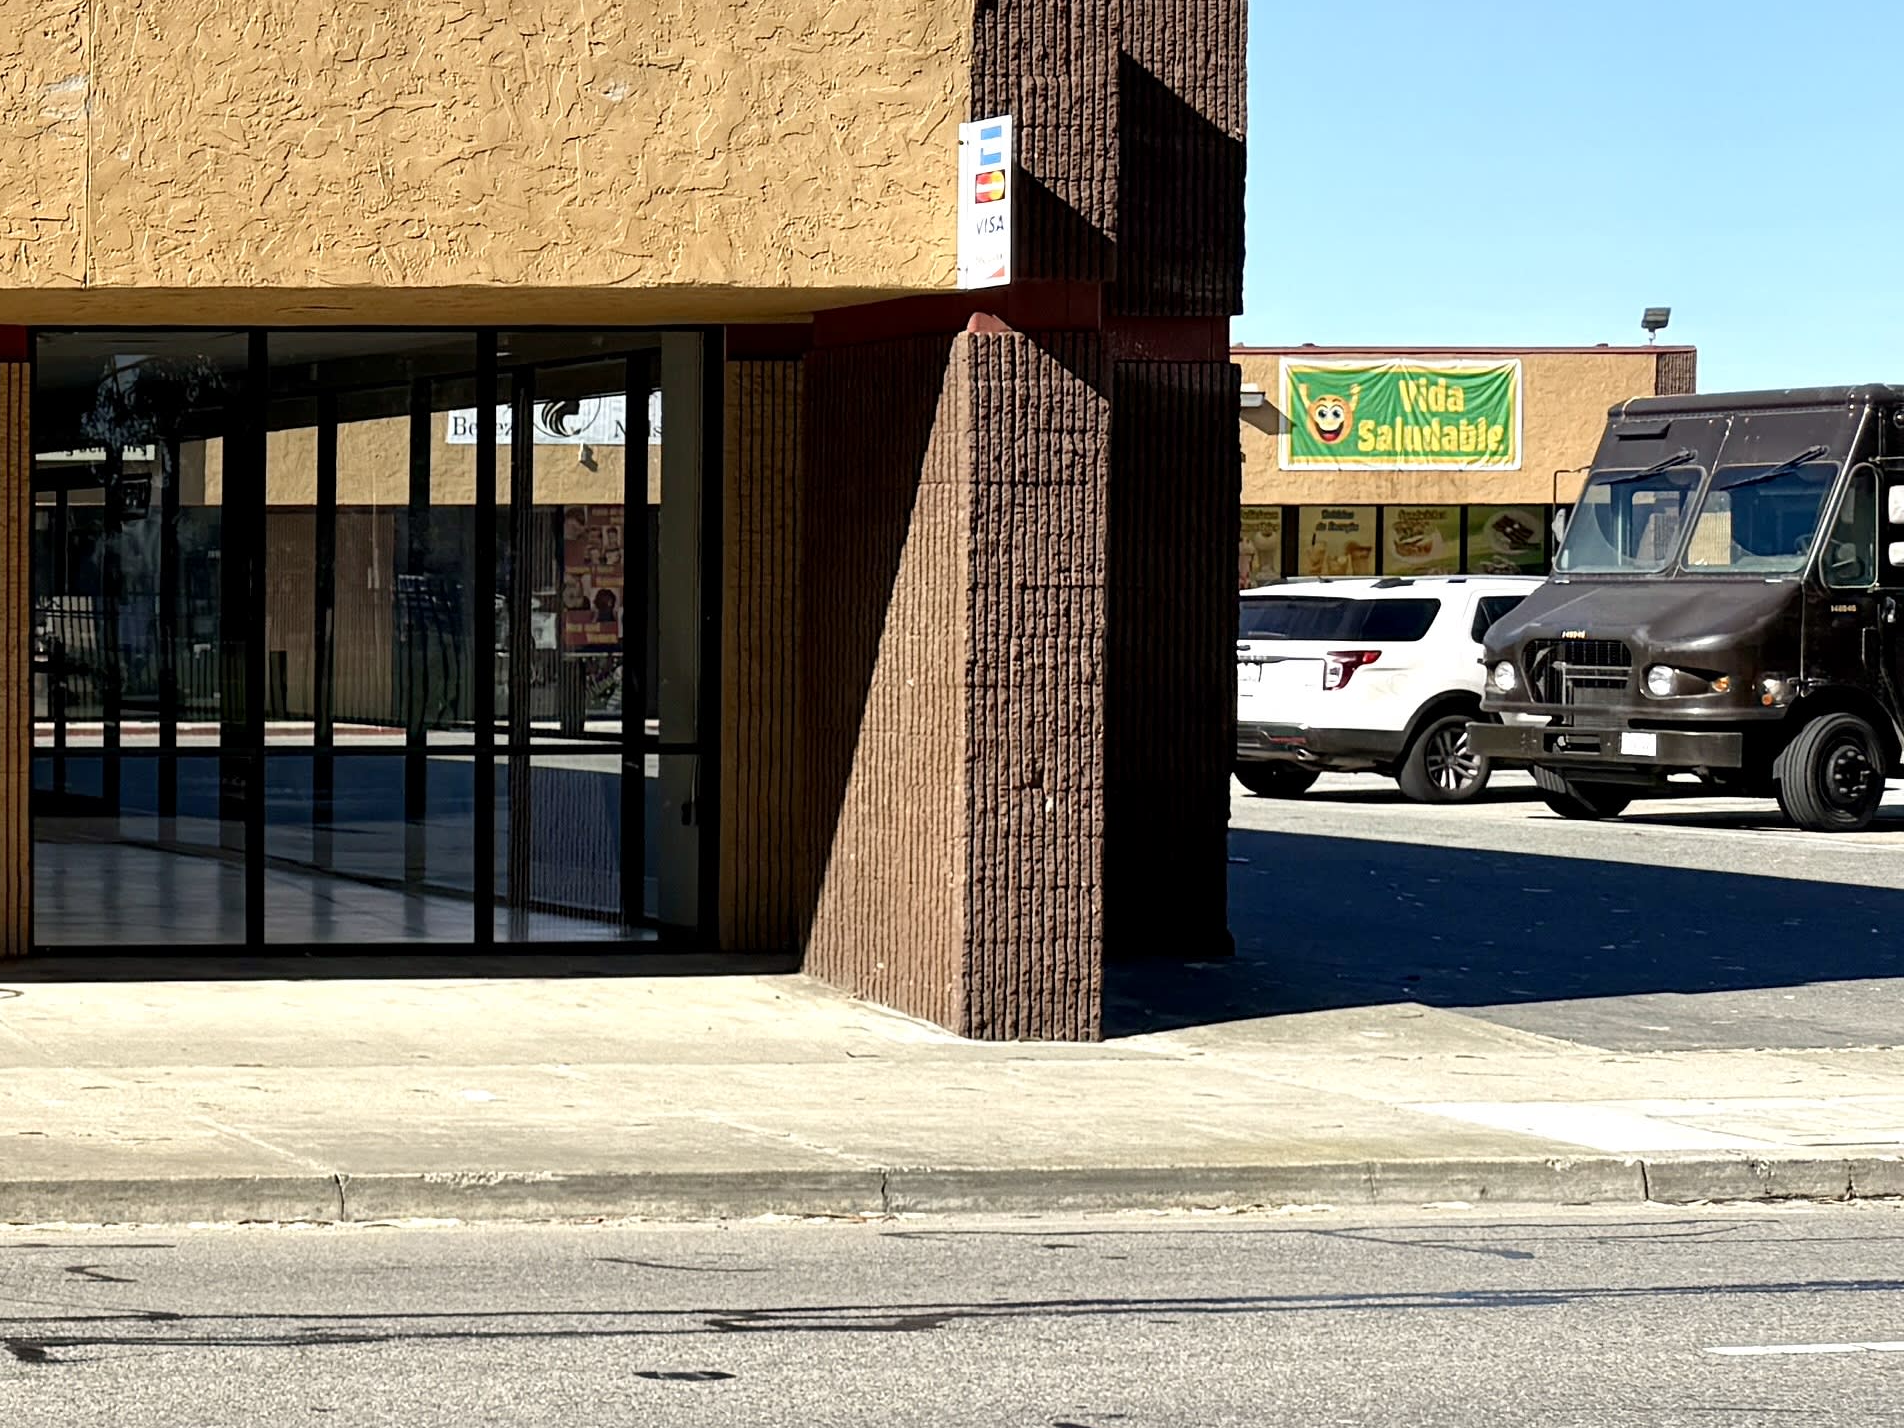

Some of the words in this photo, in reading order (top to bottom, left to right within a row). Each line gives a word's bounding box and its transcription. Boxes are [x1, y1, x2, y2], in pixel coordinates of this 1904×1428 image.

[976, 215, 1004, 235] VISA
[1398, 378, 1465, 413] Vida
[453, 416, 513, 437] Beez
[614, 419, 662, 439] Nls
[1357, 416, 1504, 453] Saludable
